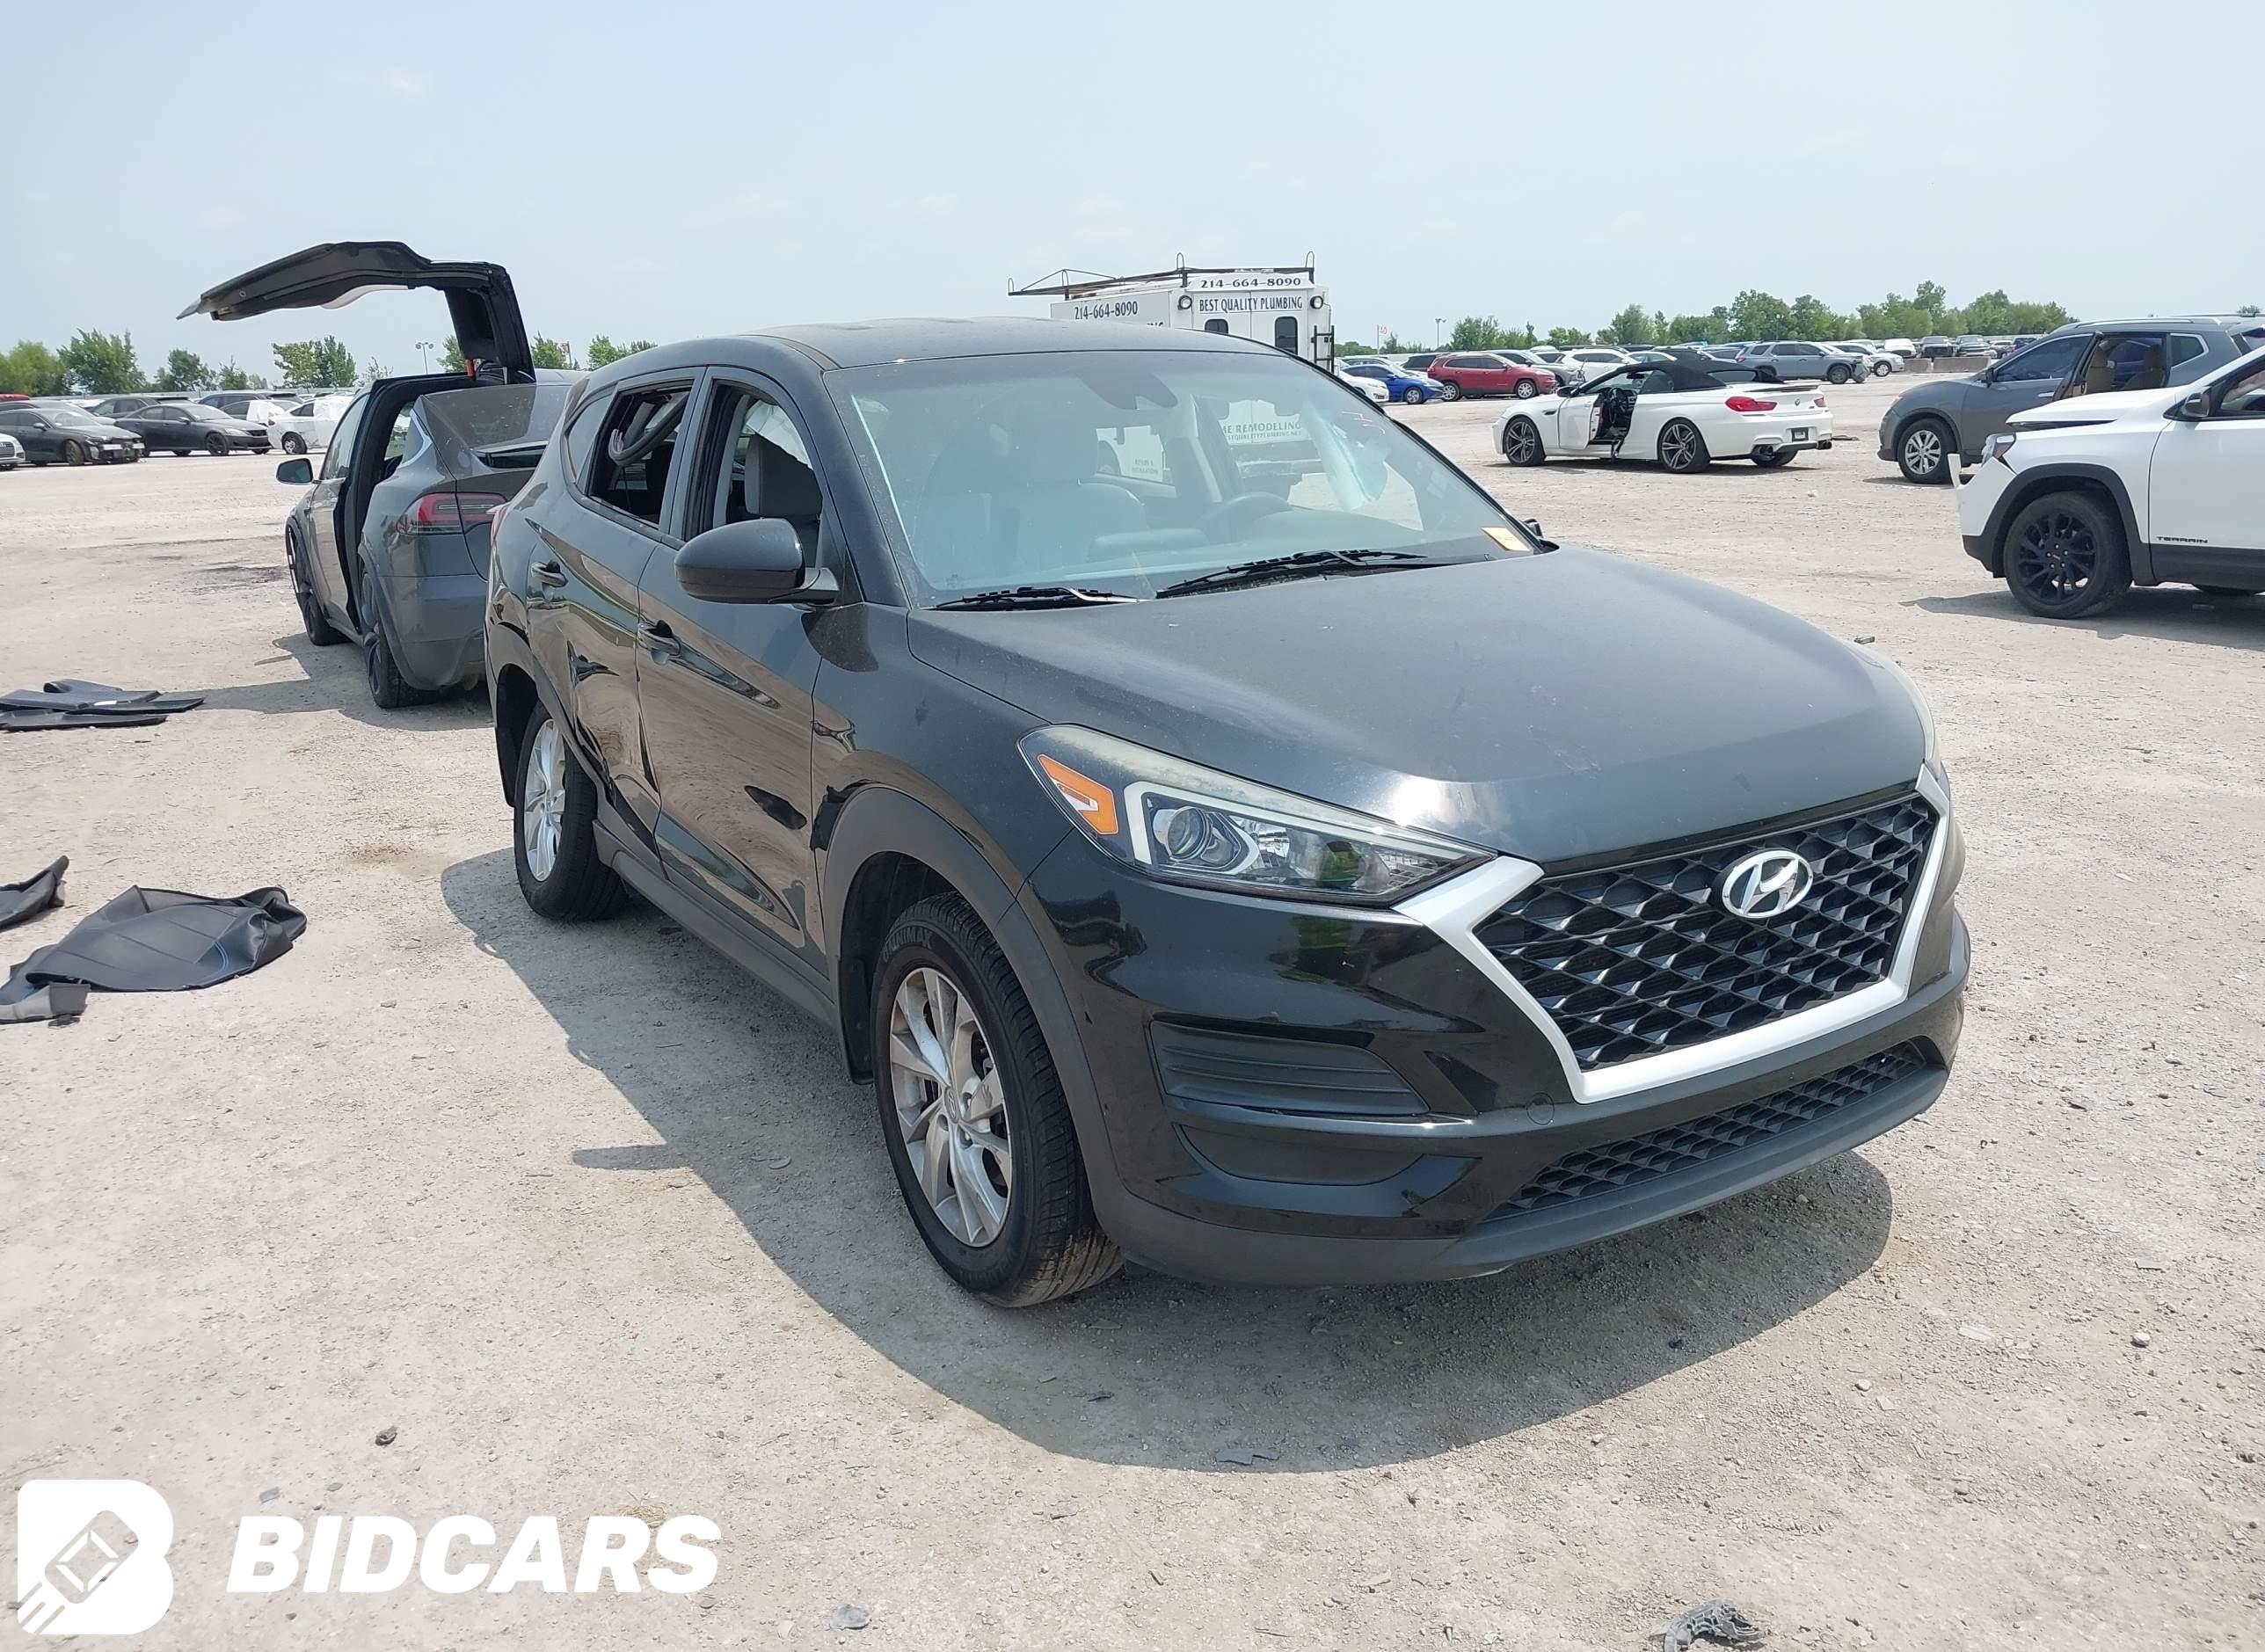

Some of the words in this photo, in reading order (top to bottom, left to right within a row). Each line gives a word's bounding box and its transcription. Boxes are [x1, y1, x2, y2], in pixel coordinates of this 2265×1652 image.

[1201, 278, 1301, 288] 214-664-8090
[1074, 301, 1138, 320] 214-664-8090
[1199, 299, 1219, 311] BEST
[1221, 297, 1258, 313] QUALITY
[1261, 295, 1302, 309] PLUMBING
